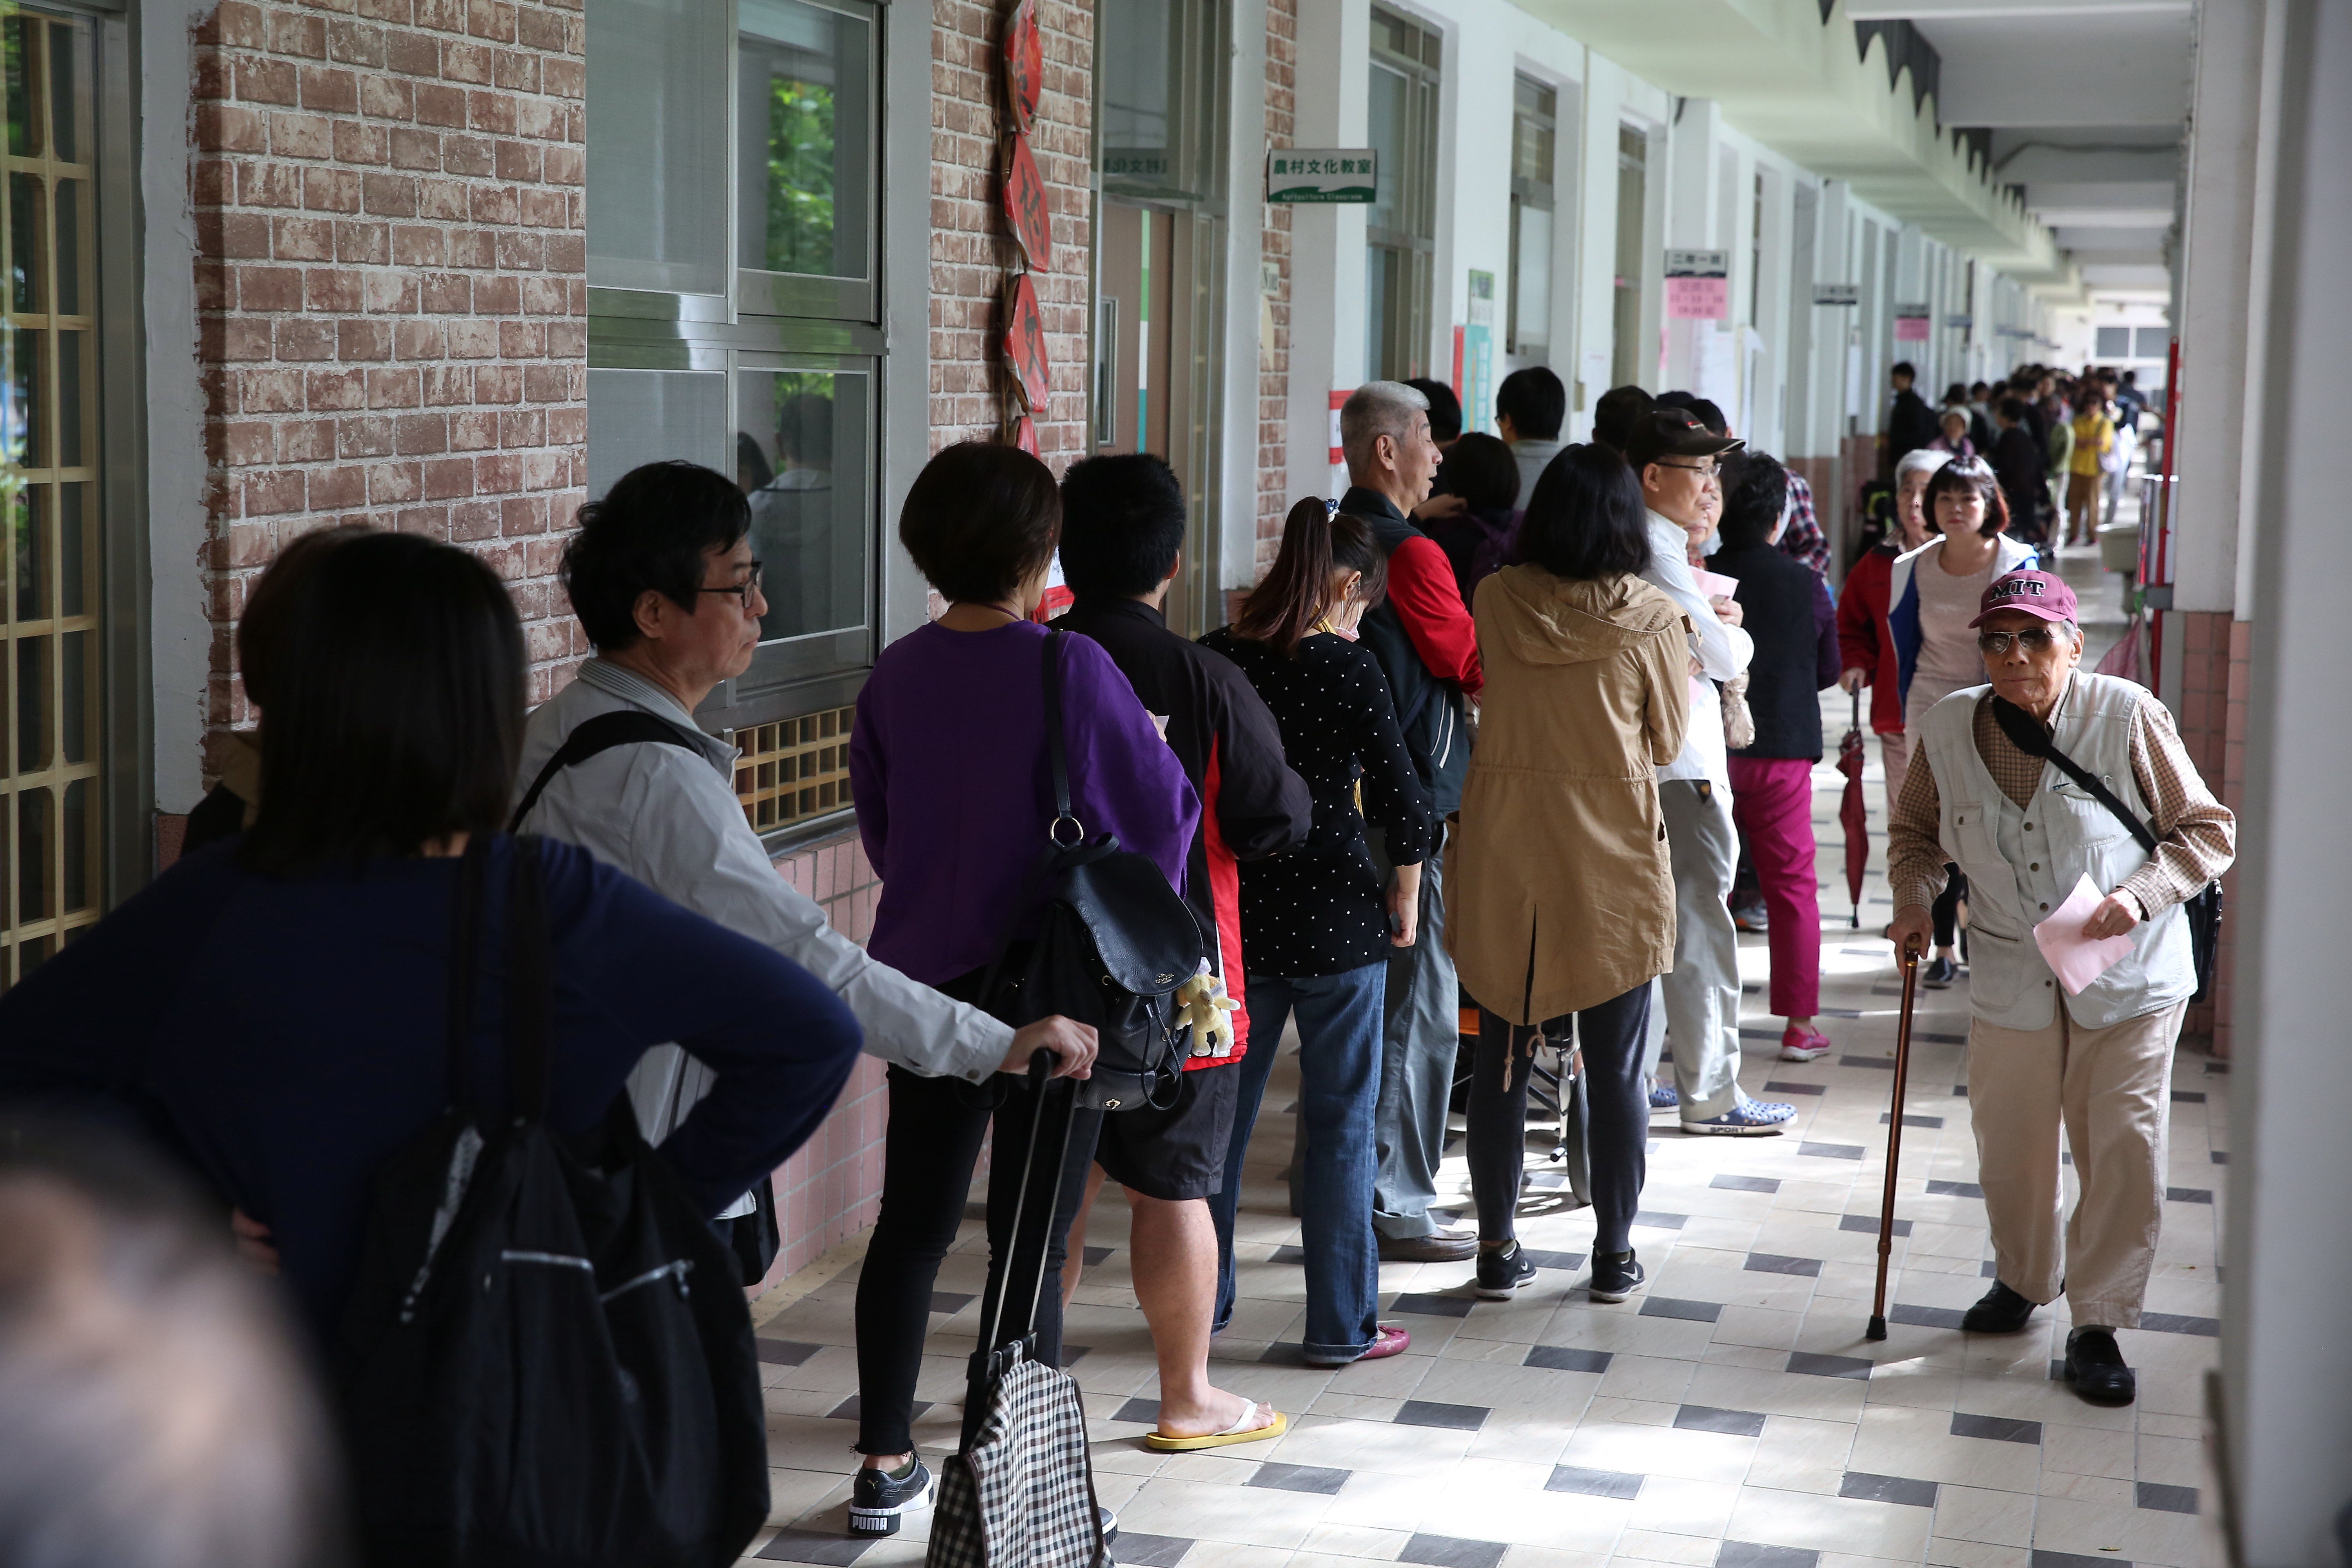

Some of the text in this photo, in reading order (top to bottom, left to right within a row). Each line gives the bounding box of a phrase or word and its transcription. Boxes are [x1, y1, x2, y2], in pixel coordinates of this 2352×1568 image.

[1273, 158, 1372, 174] 農村文化教室
[1989, 579, 2046, 602] MIT
[852, 1515, 888, 1530] PUMA
